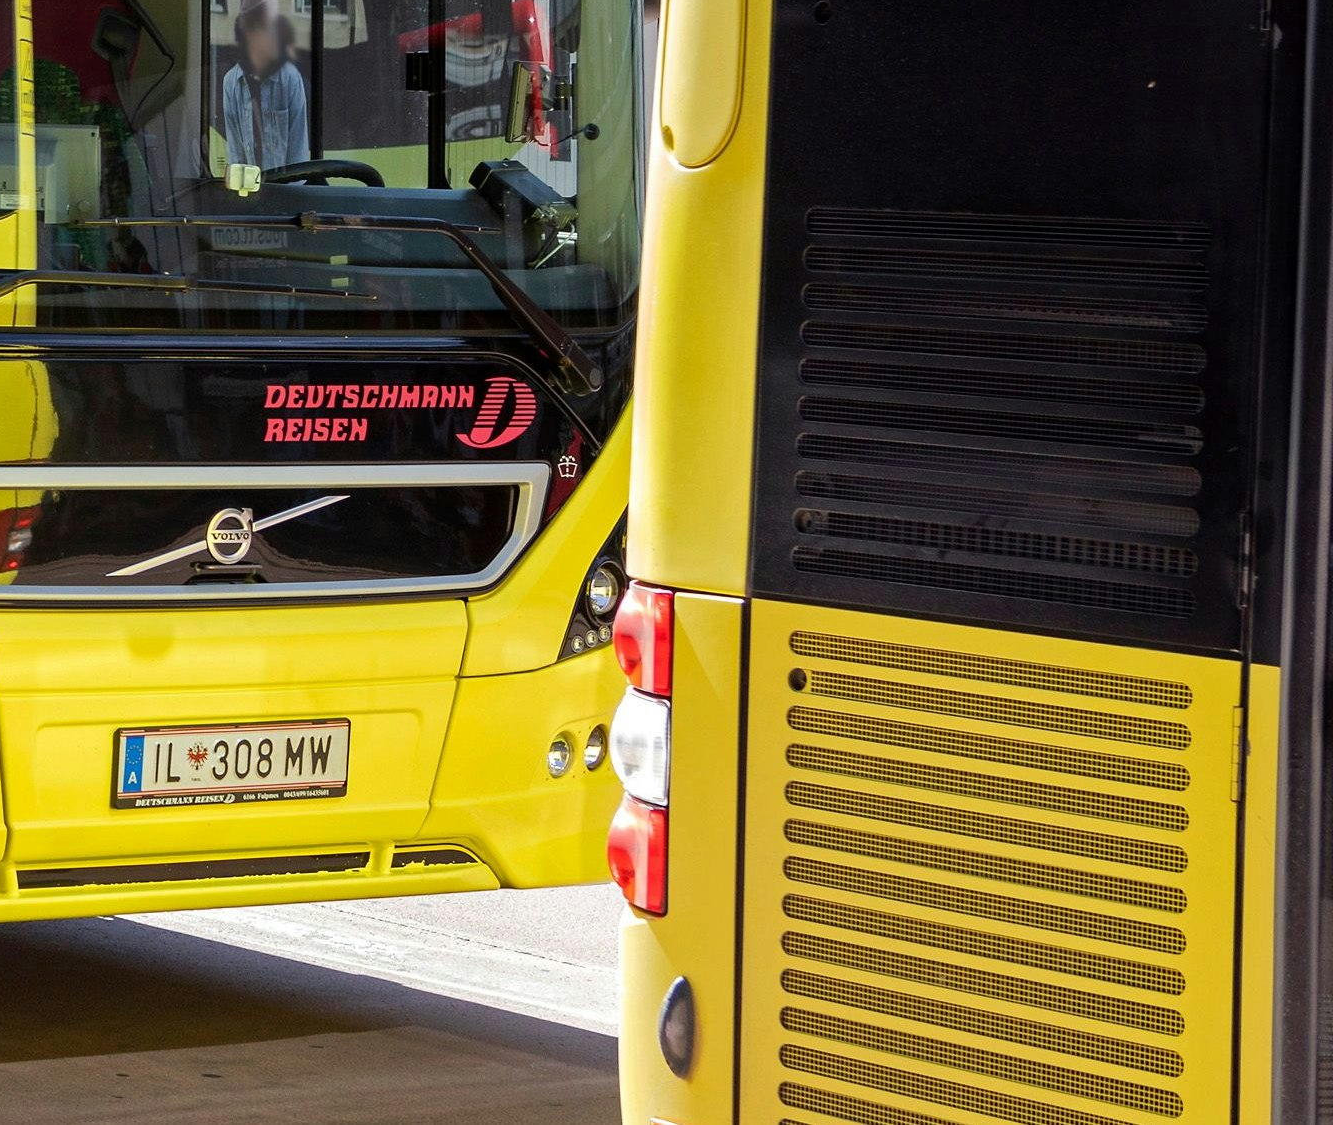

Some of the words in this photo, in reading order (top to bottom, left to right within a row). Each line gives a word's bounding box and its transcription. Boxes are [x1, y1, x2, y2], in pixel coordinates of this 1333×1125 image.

[263, 385, 475, 409] DEUTSCHMANN
[263, 418, 368, 442] REISEN
[211, 532, 250, 540] VOLVO
[127, 771, 138, 784] A
[155, 742, 181, 783] IL
[212, 738, 274, 780] 308
[284, 735, 332, 777] MW
[135, 796, 194, 807] DEUTSCHMANN
[195, 795, 225, 805] REISEN
